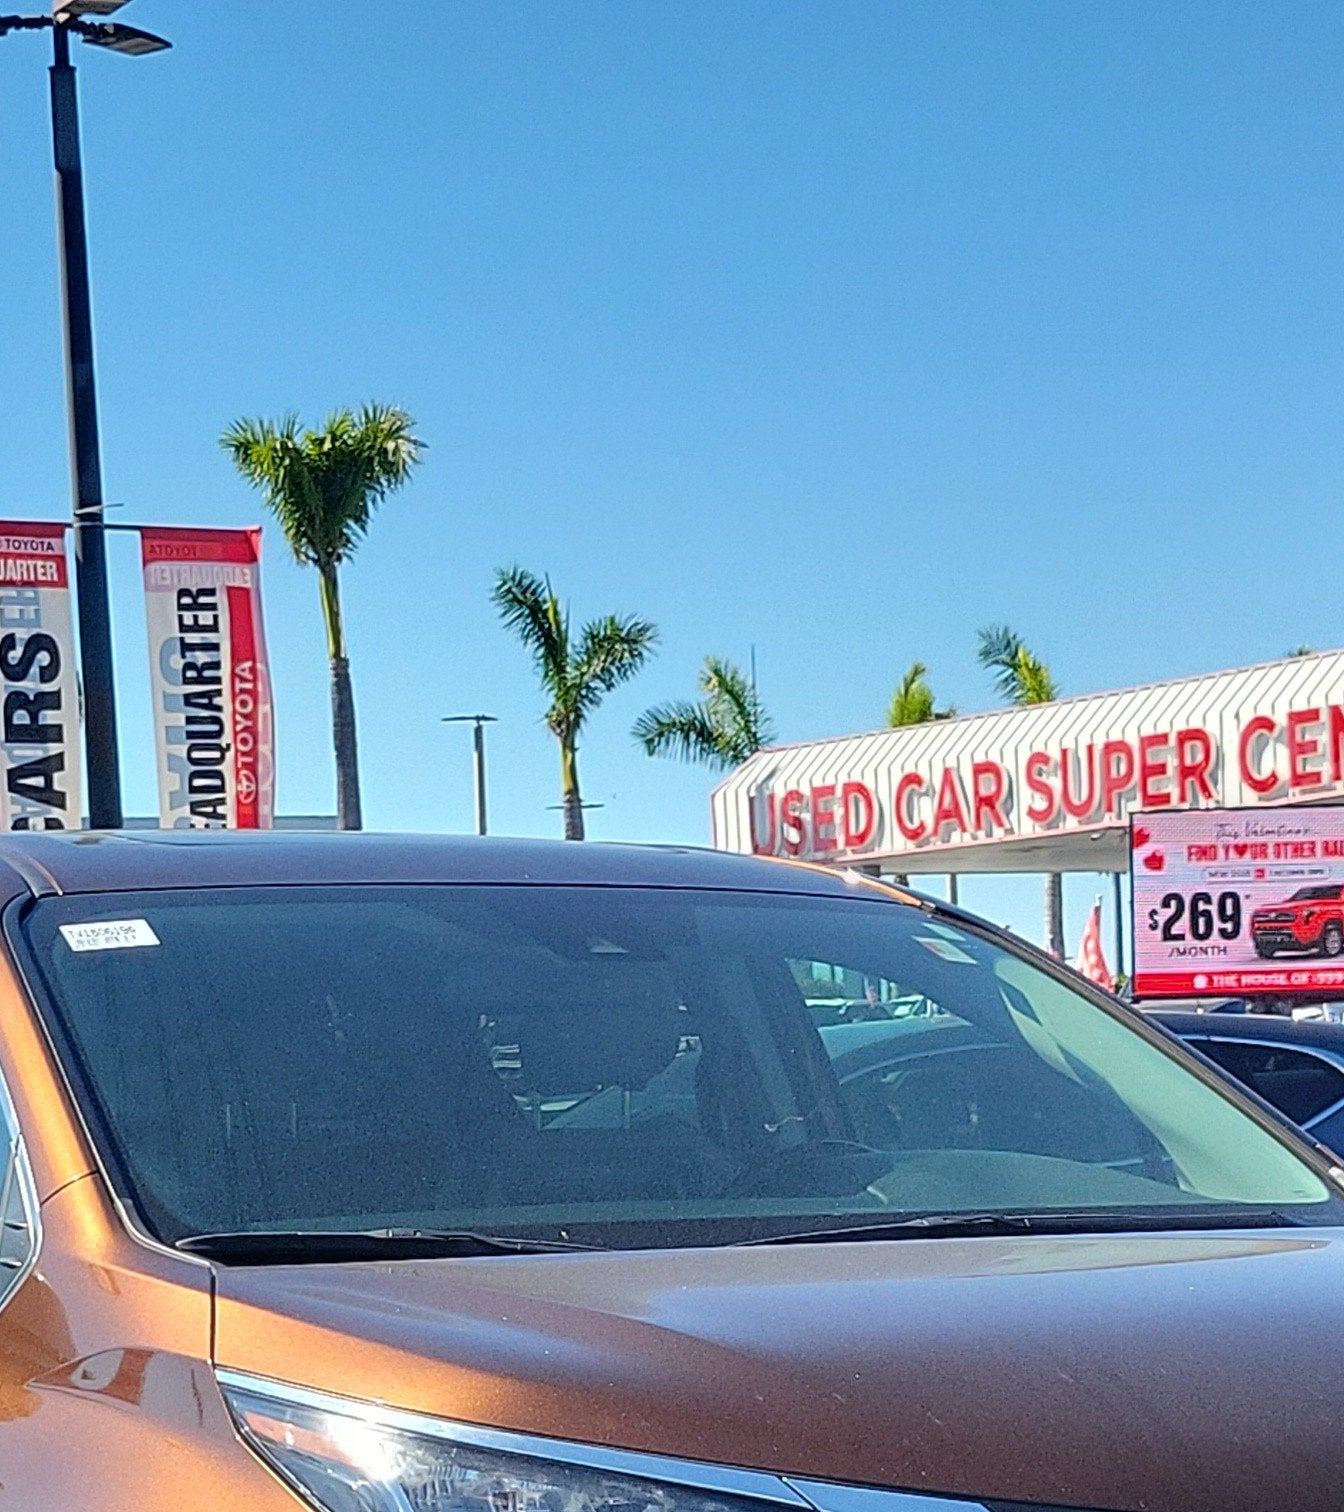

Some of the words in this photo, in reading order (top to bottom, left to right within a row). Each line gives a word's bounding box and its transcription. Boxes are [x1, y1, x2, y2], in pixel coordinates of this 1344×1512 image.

[4, 537, 55, 553] TOYOTA
[177, 587, 230, 829] ADQUARTER
[234, 660, 255, 768] TOYOTA
[749, 781, 876, 857] USED
[894, 760, 1007, 841] CAR
[1025, 727, 1215, 824] SUPER
[1272, 841, 1316, 859] OTHER
